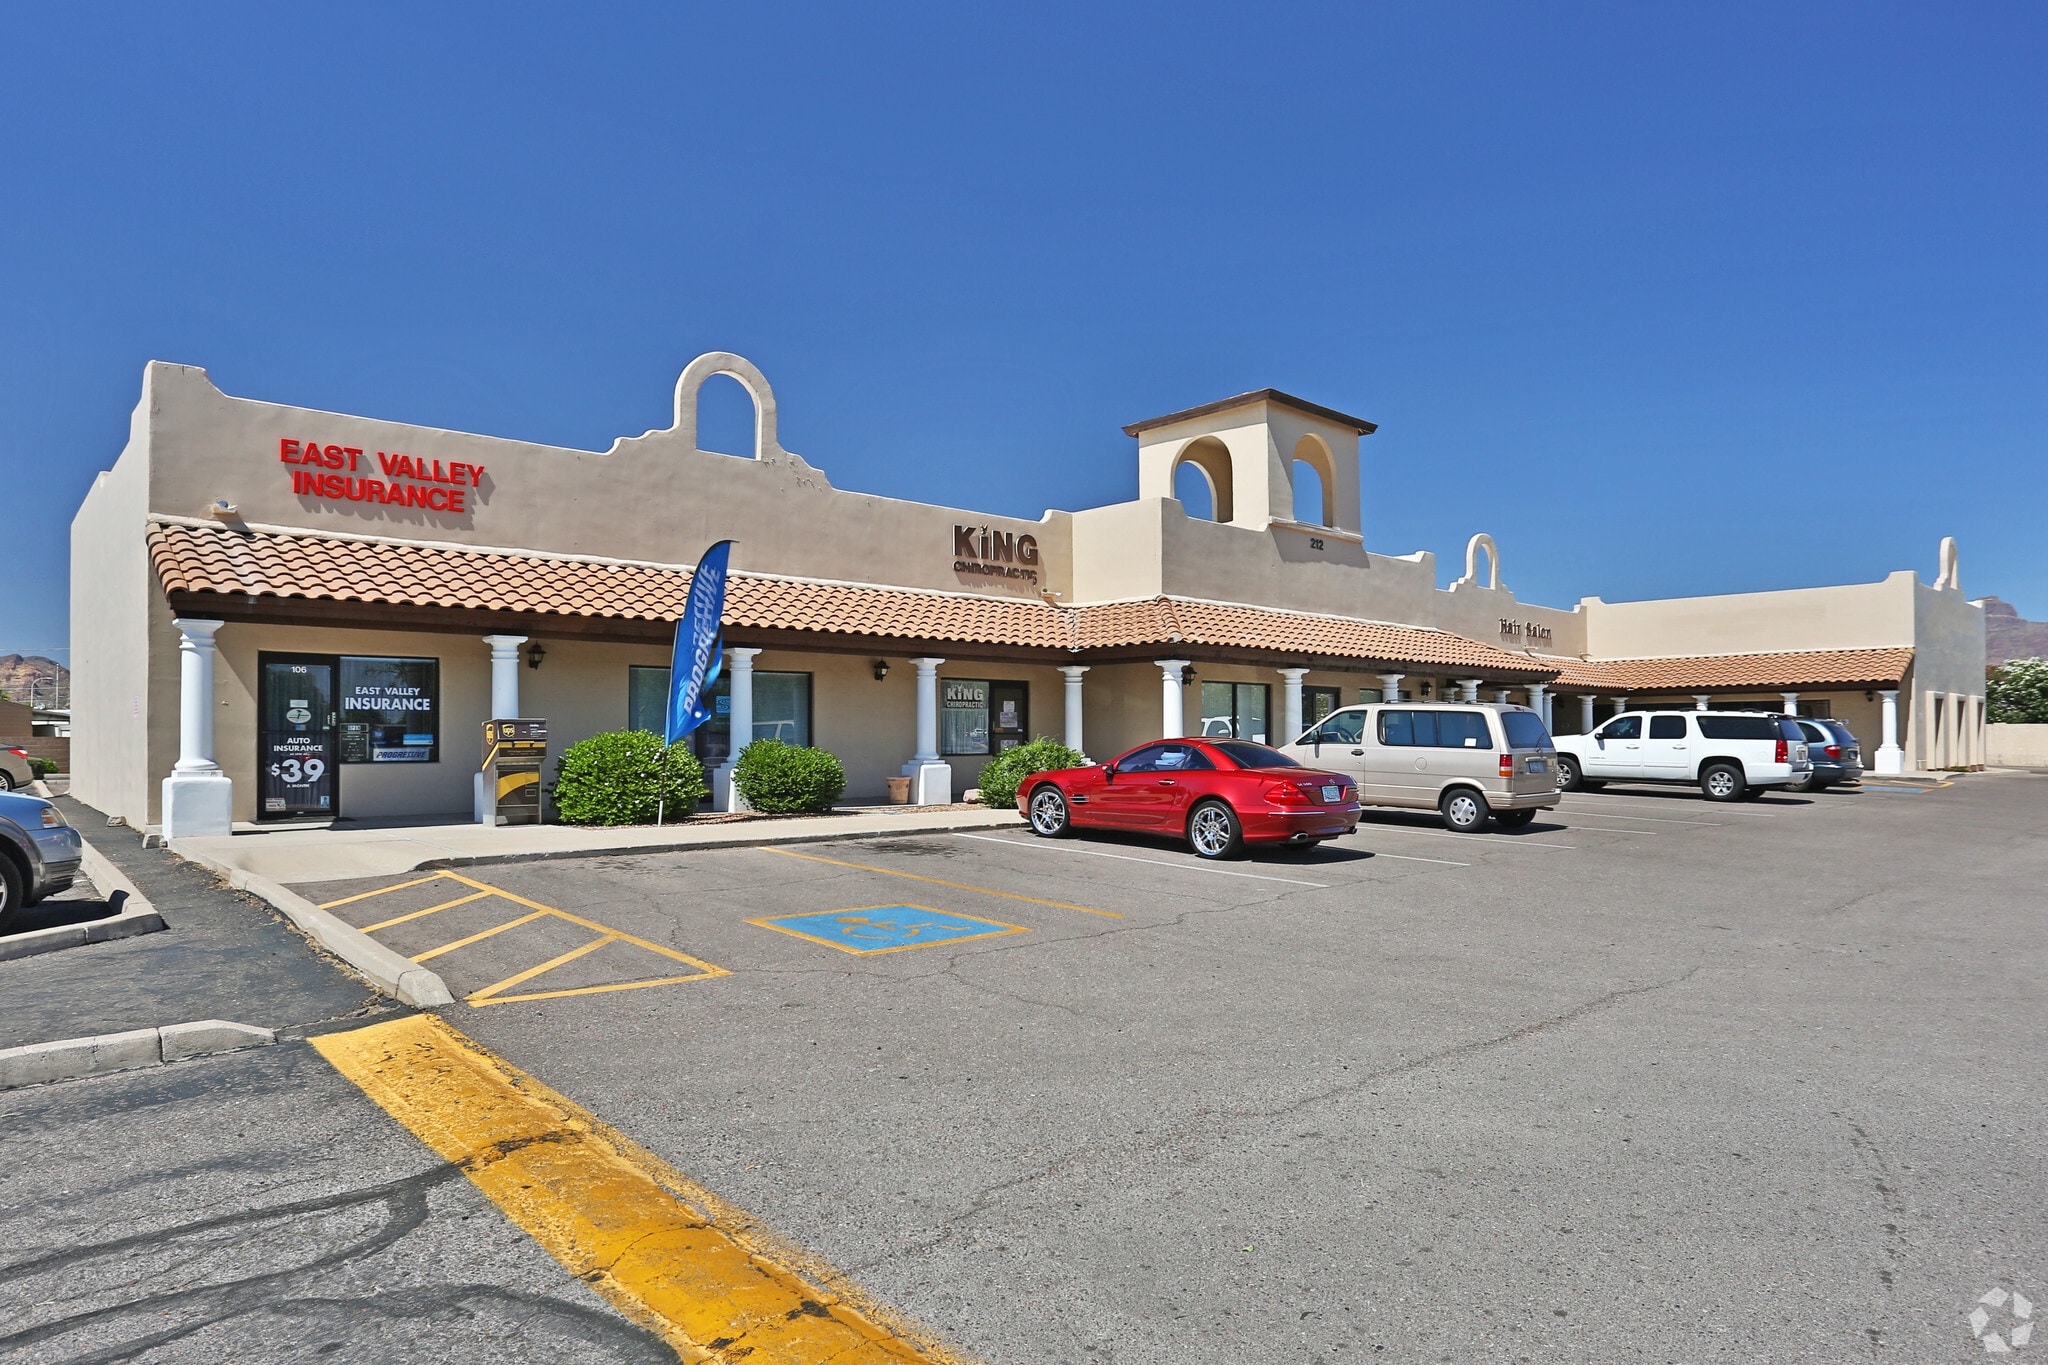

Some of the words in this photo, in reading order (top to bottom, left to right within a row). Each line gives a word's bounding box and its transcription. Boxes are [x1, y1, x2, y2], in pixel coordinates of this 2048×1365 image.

[280, 438, 363, 471] EAST
[377, 452, 485, 487] VALLEY
[293, 470, 465, 512] INSURANCE
[1310, 537, 1324, 551] 212
[1499, 617, 1521, 635] Hair
[1525, 621, 1551, 640] Salon
[355, 686, 381, 695] EAST
[384, 687, 421, 696] VALLEY
[345, 697, 431, 711] INSURANCE
[376, 751, 426, 759] PROGRESSIVE
[271, 758, 325, 783] $39
